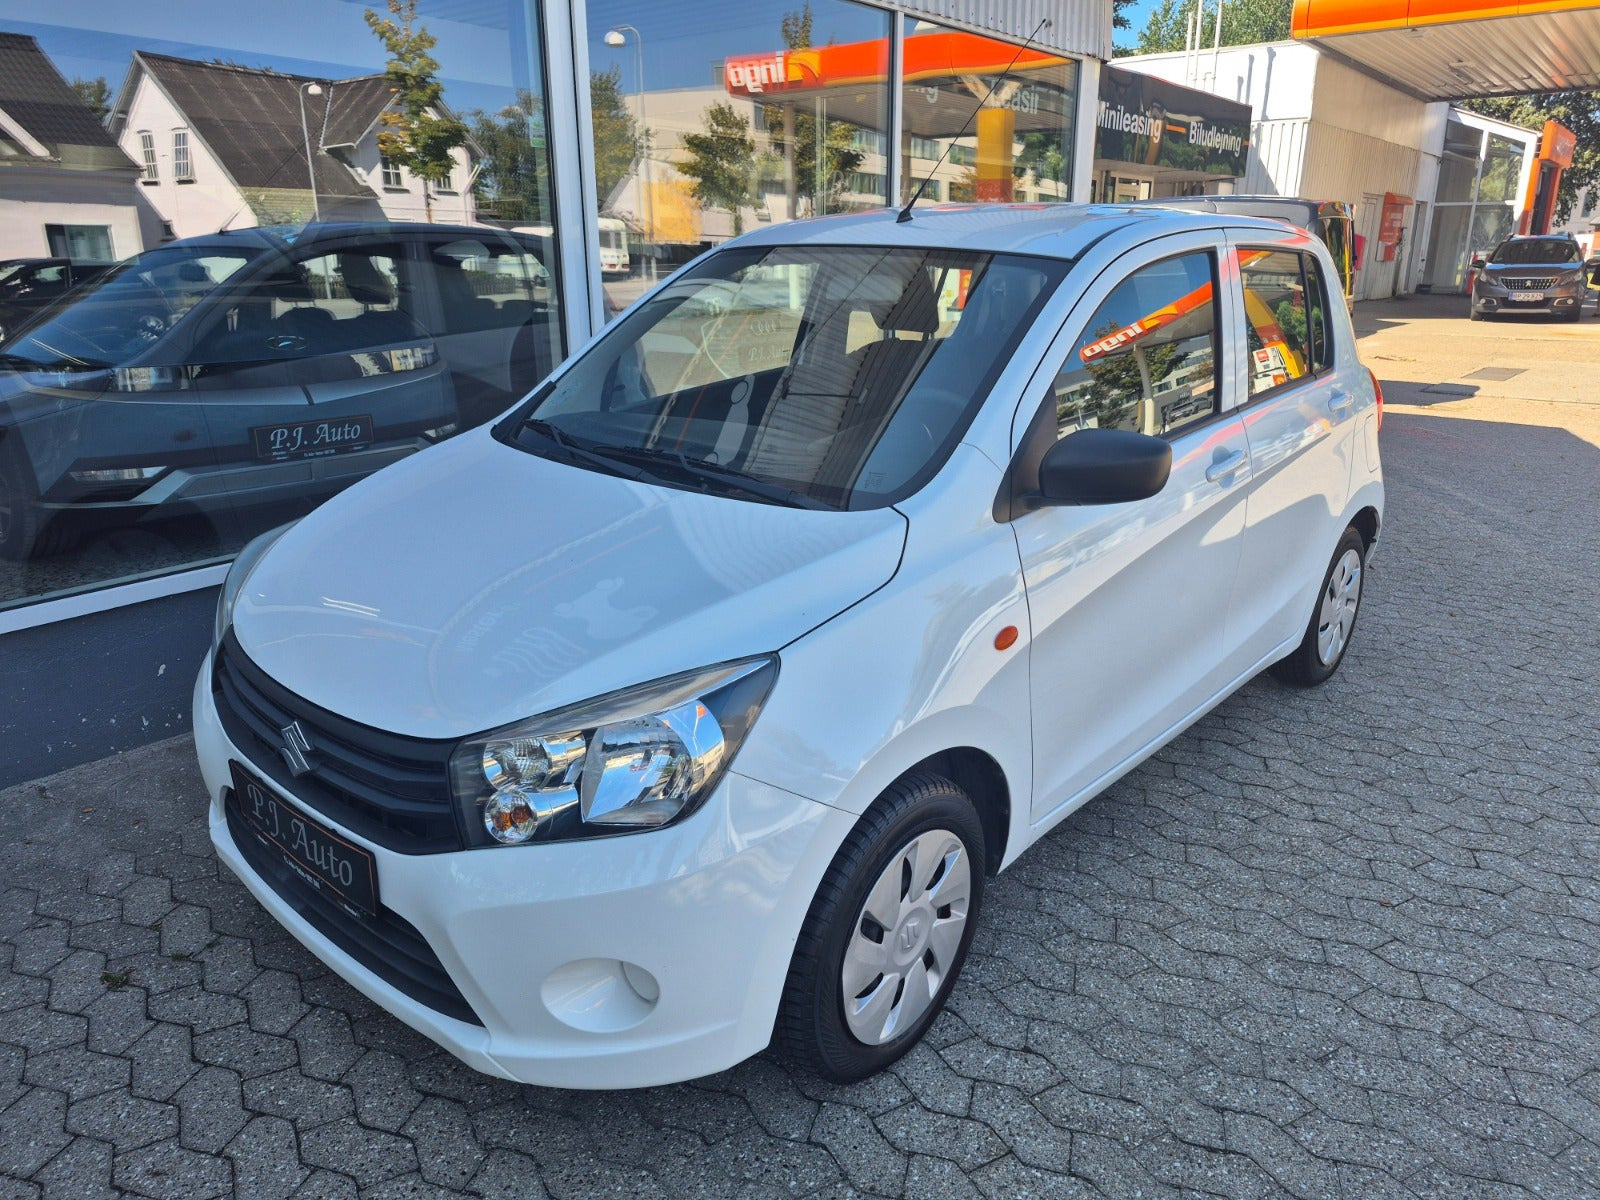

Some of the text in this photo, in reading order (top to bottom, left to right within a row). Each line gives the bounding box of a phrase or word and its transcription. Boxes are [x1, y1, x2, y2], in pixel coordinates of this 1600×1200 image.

[1096, 100, 1242, 157] Minileasing Biludlejning
[270, 423, 361, 450] P.J. Auto
[247, 784, 286, 840] P.J.
[291, 818, 353, 886] Auto
